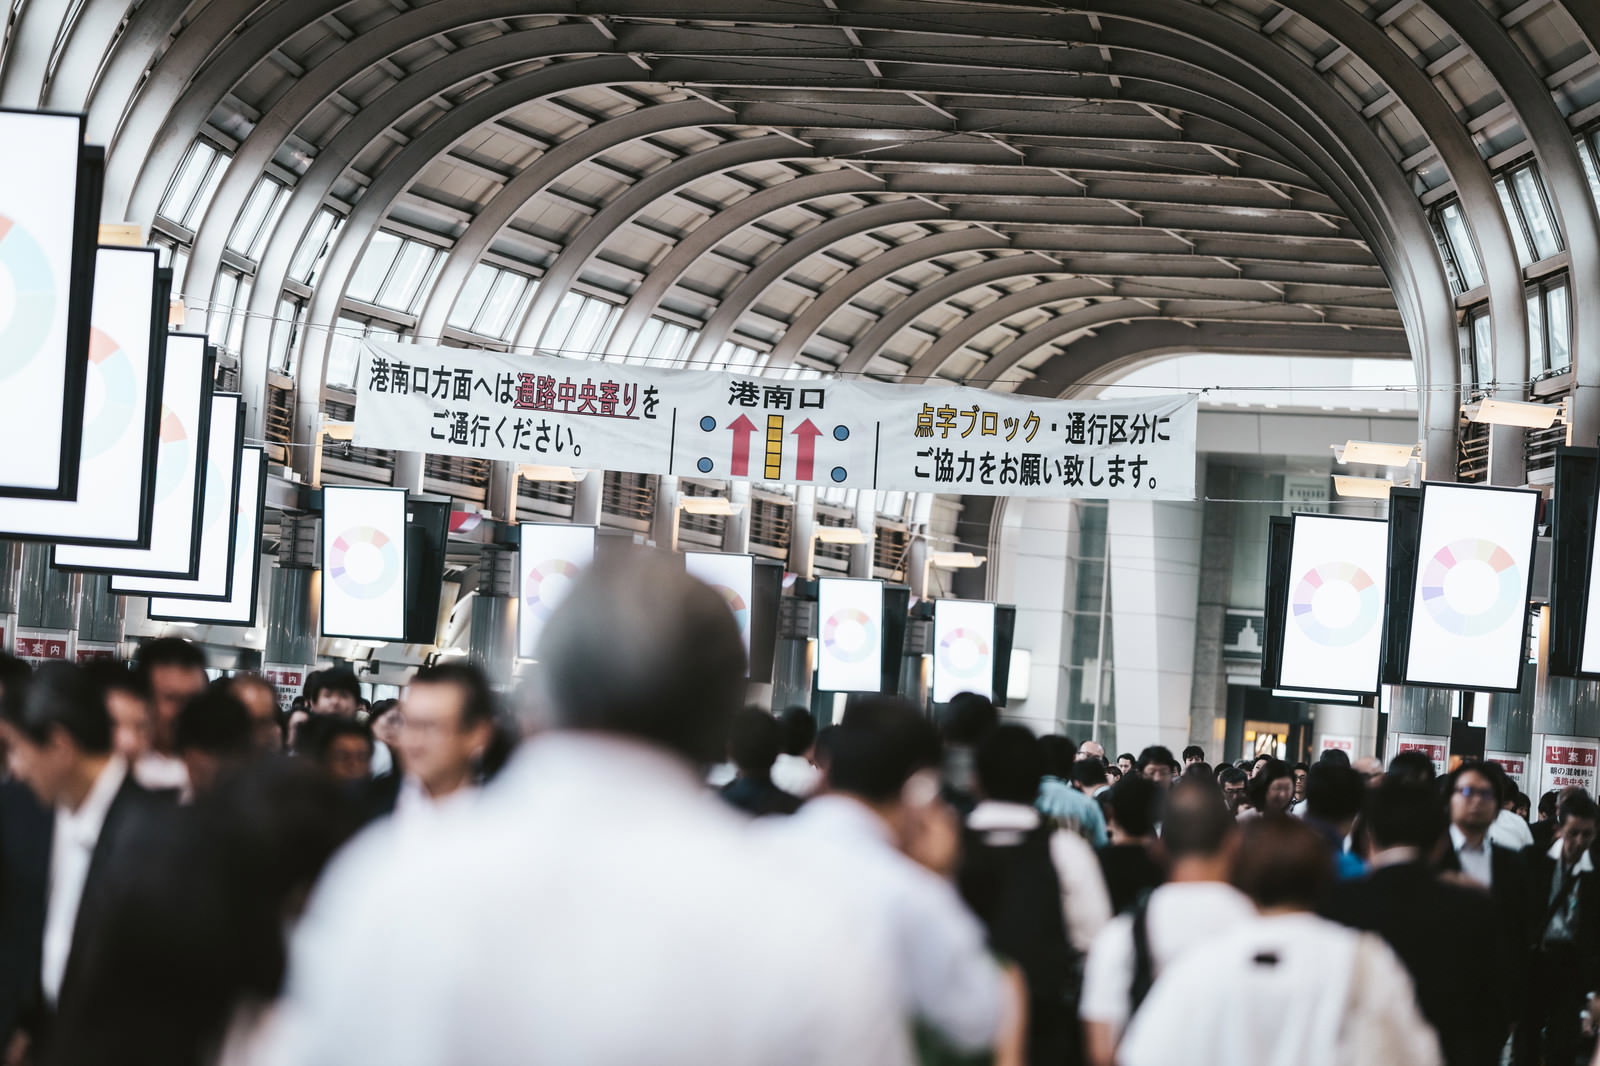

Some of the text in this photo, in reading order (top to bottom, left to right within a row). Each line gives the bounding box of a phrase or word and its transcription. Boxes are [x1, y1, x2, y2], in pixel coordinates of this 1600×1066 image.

[369, 358, 660, 419] 港南口方面へは通路中央寄りを
[728, 381, 825, 410] 港南口
[431, 409, 581, 456] ご通行ください。
[915, 403, 1170, 445] 点字ブロック・通行区分に
[915, 447, 1157, 489] ご協力をお願い致します。
